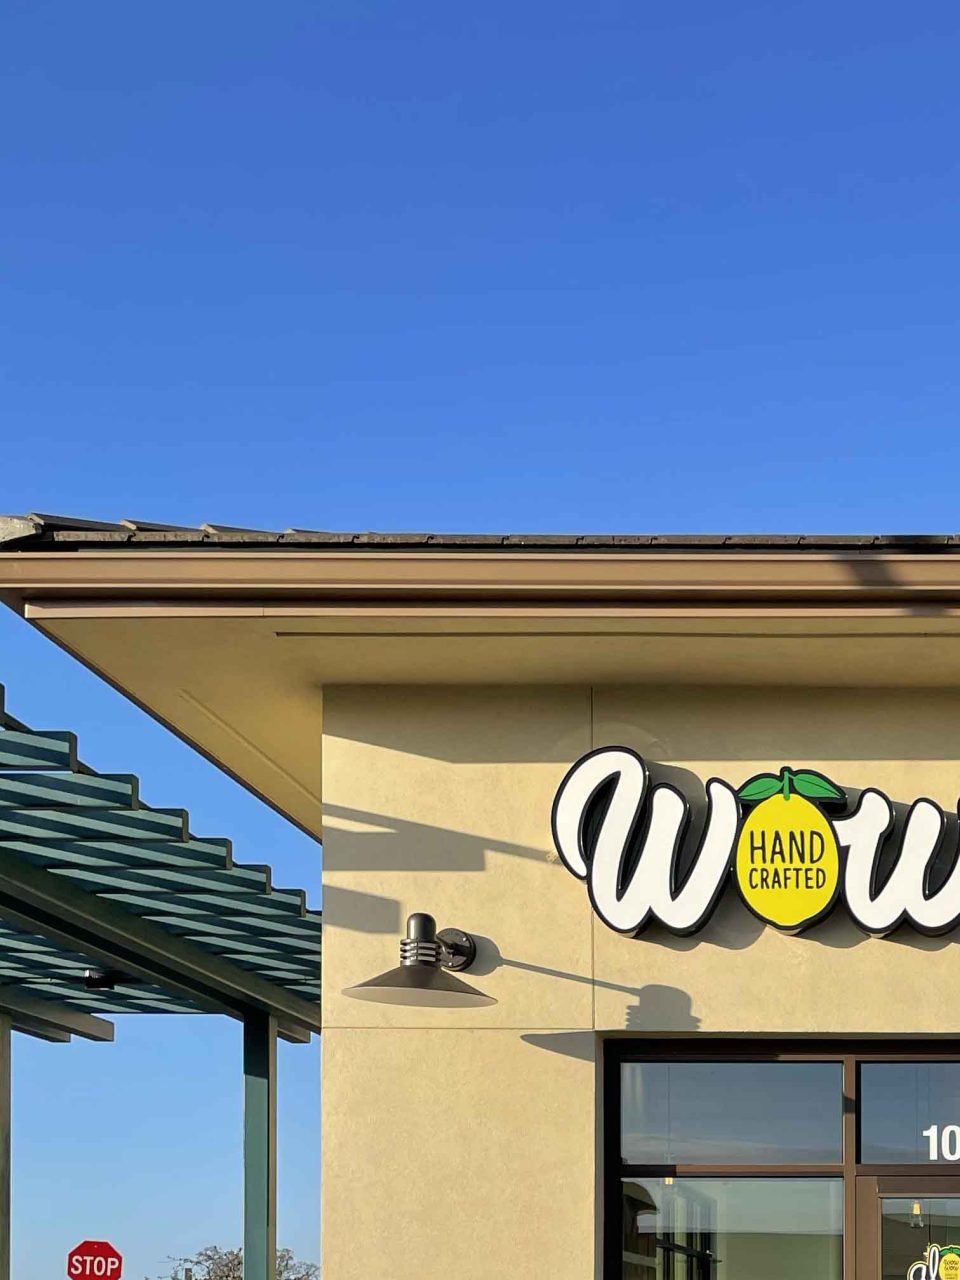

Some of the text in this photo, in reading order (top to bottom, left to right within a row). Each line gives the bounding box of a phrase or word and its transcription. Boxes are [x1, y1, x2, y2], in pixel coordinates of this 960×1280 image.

[749, 830, 825, 864] HAND
[748, 867, 826, 890] CRAFTED
[71, 1255, 119, 1276] STOP
